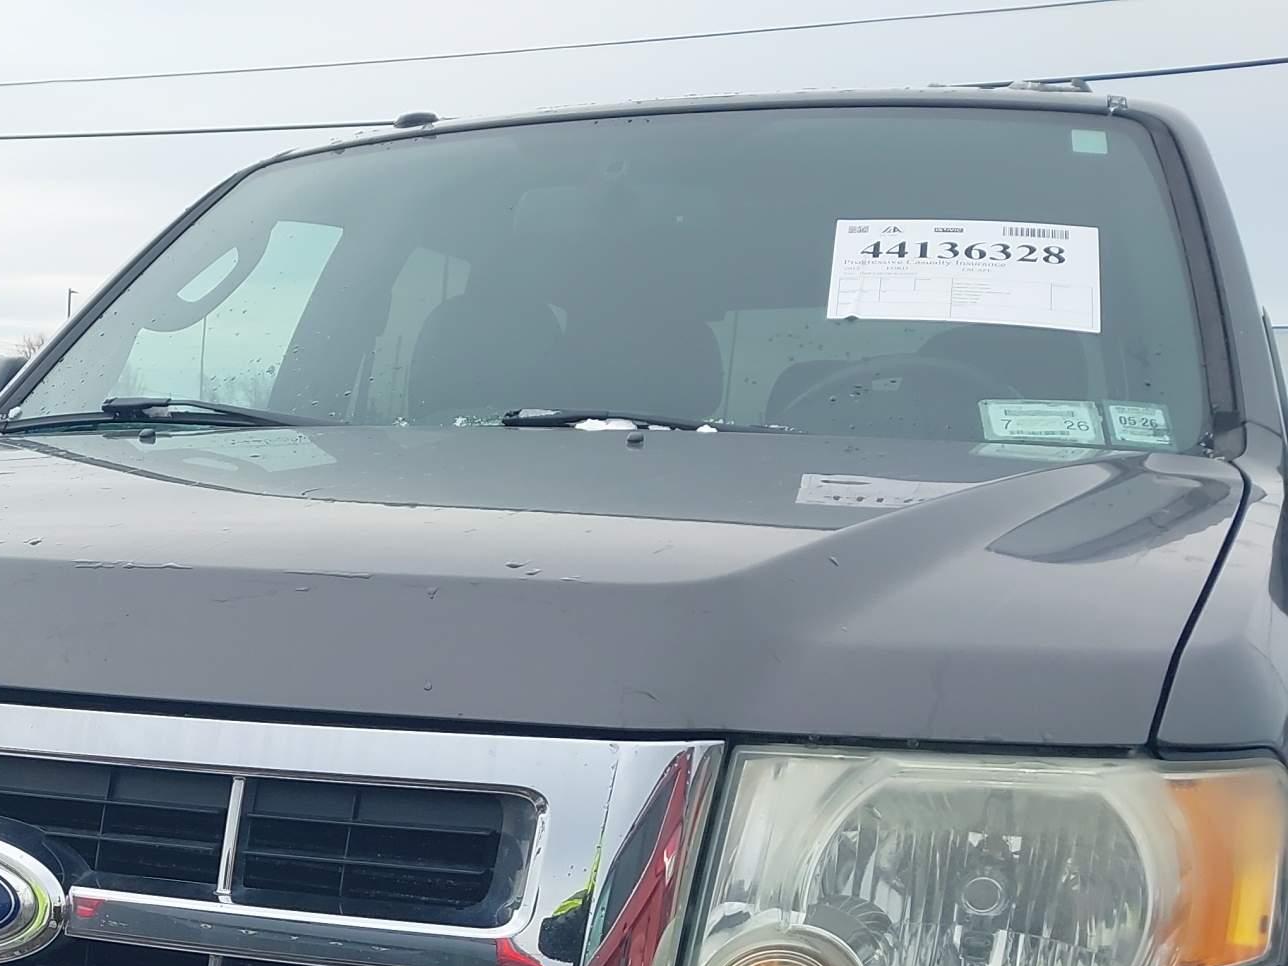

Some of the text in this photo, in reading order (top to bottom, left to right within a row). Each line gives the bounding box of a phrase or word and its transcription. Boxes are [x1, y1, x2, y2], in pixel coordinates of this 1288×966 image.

[860, 240, 1066, 265] 44136328
[1000, 418, 1090, 432] 7 26
